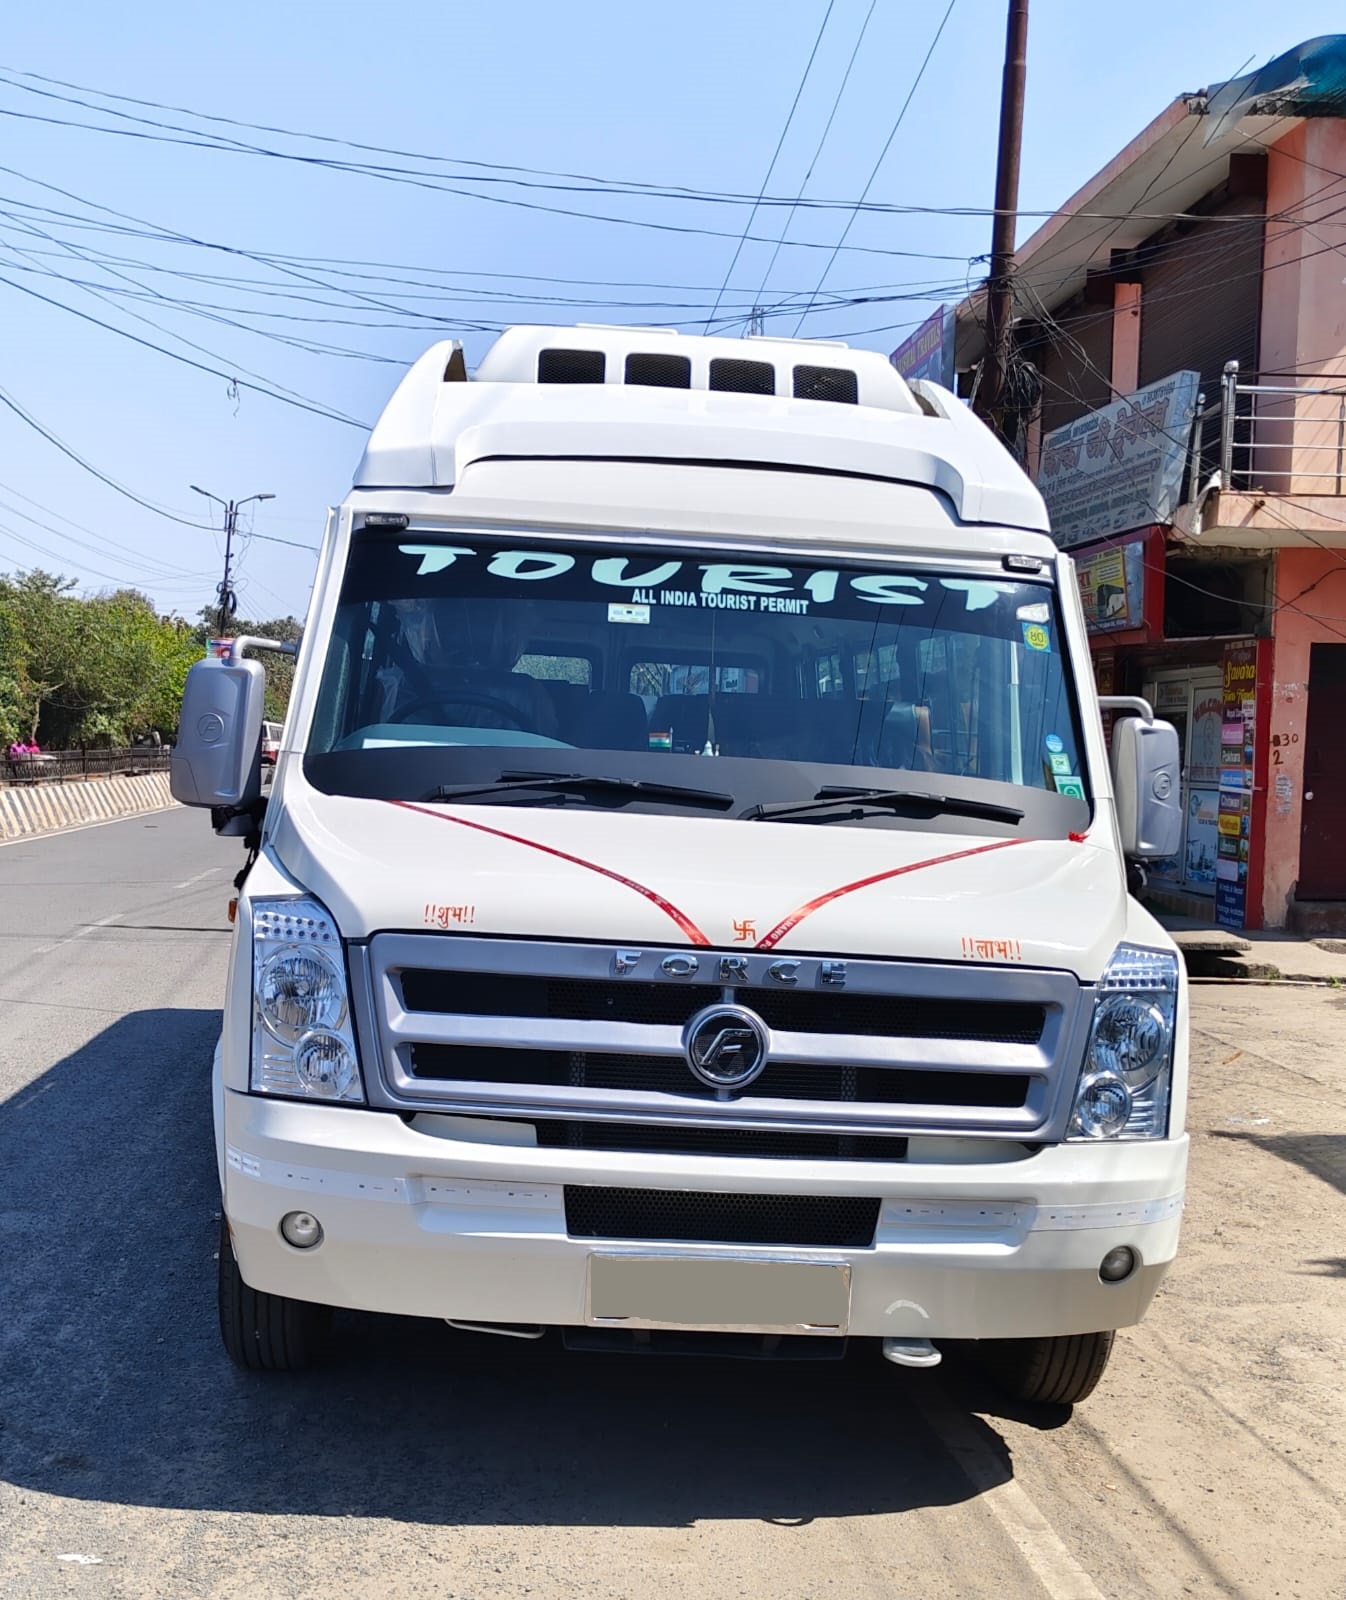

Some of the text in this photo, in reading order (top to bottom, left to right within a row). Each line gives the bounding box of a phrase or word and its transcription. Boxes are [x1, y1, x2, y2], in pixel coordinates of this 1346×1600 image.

[398, 544, 1017, 611] TOURIST
[632, 589, 809, 615] ALL INDIA TOURIST PERMIT
[615, 950, 849, 985] FORCE
